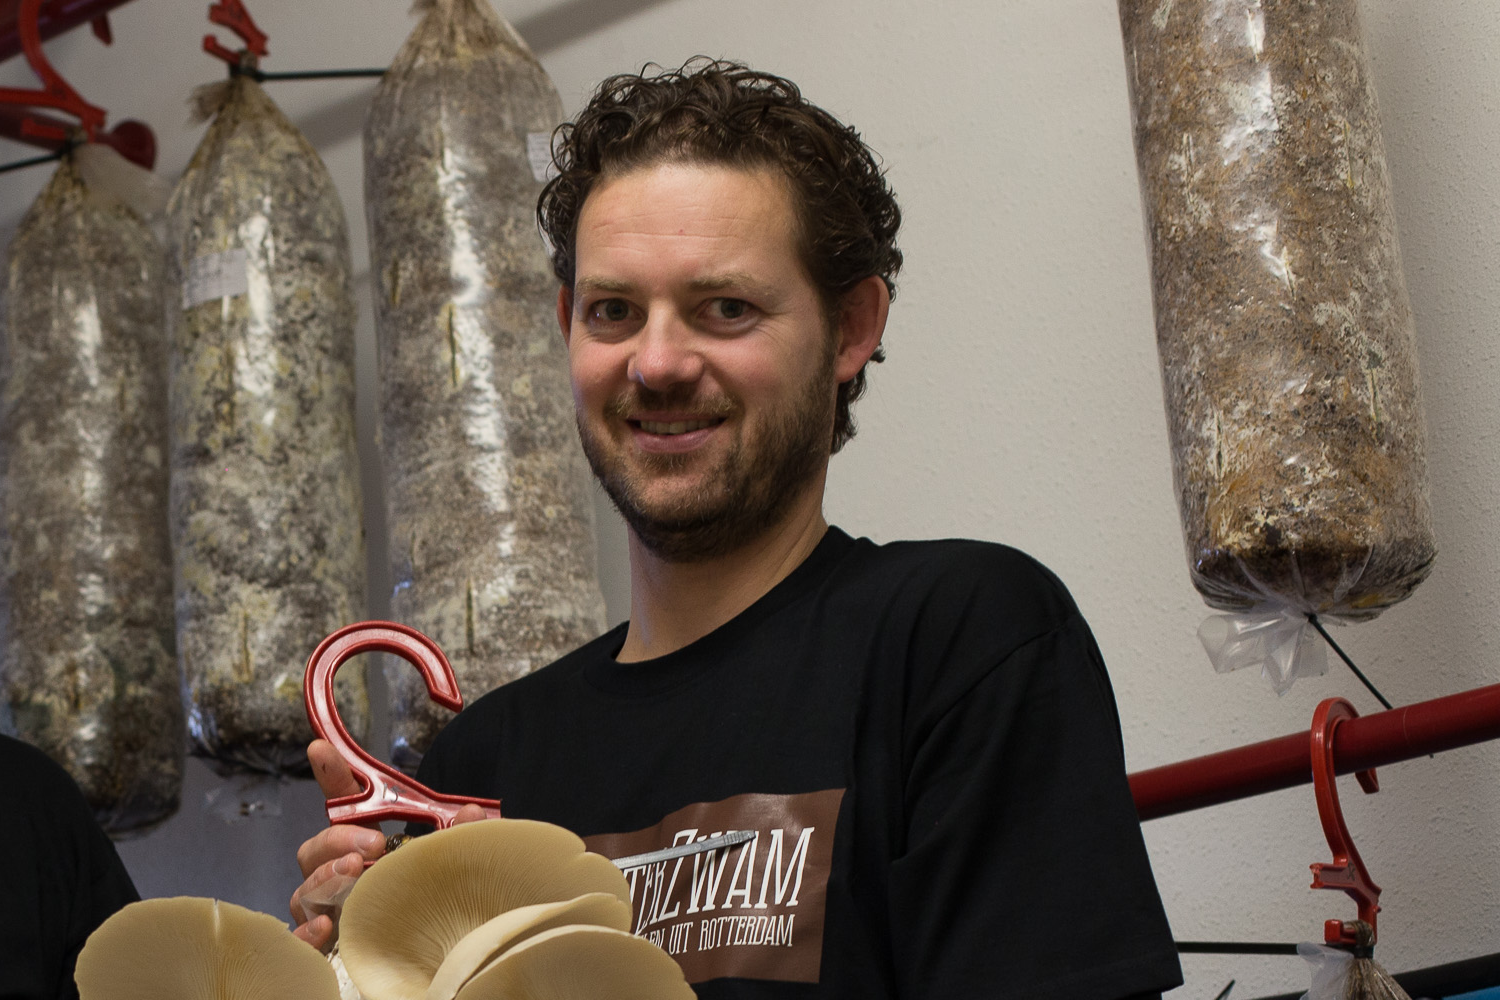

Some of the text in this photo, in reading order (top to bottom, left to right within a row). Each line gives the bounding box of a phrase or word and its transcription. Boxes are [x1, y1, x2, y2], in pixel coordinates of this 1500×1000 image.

[624, 826, 815, 934] TERZWAM
[669, 922, 694, 956] UIT
[698, 914, 796, 952] ROTTERDAM
